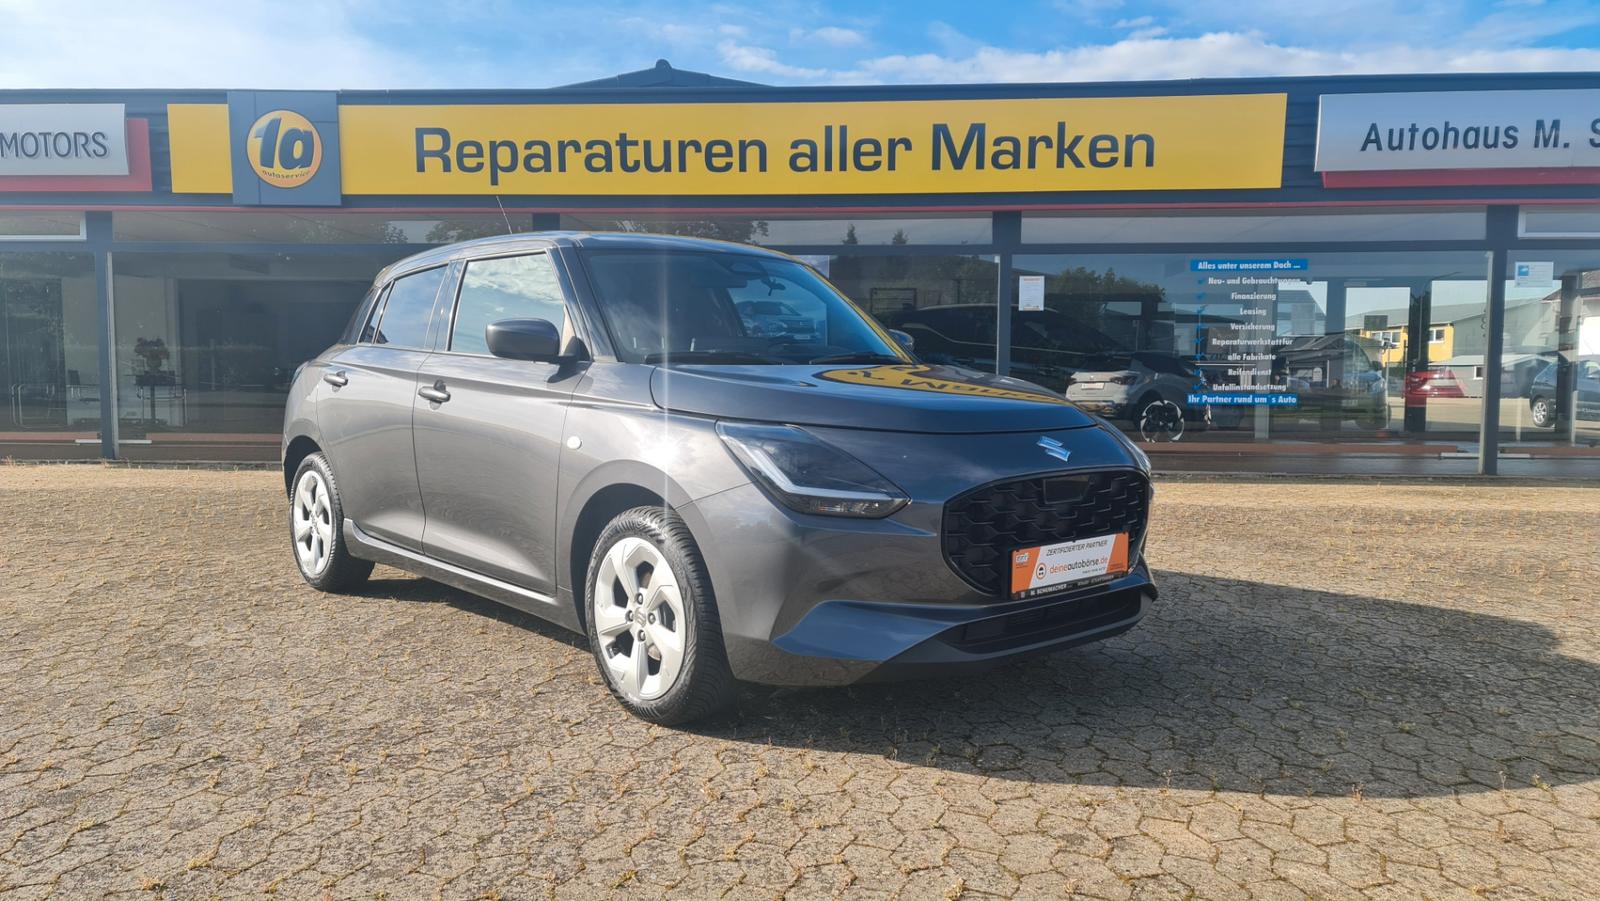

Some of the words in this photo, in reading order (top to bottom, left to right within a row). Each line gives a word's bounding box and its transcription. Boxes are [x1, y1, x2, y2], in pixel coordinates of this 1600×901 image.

[1360, 120, 1519, 152] Autohaus
[1533, 119, 1570, 149] M.
[0, 131, 108, 158] MOTORS
[254, 117, 315, 170] 1a
[414, 126, 768, 185] Reparaturen
[788, 123, 911, 173] aller
[931, 121, 1156, 171] Marken
[1198, 261, 1216, 270] Alles
[1217, 262, 1237, 270] unter
[1239, 262, 1272, 270] unserem
[1273, 261, 1291, 269] Dach
[1208, 276, 1225, 285] Neu-
[1226, 276, 1240, 284] und
[1231, 291, 1276, 301] Finanzierung
[1239, 307, 1267, 316] Leasing
[1230, 322, 1276, 331] Versicherung
[1227, 353, 1241, 361] alle
[1242, 353, 1276, 361] Fabrikate
[1227, 368, 1272, 376] Reifendienst
[1188, 395, 1200, 403] Ihr
[1202, 395, 1232, 403] Partner
[1234, 395, 1253, 403] rund
[1278, 395, 1297, 403] Auto
